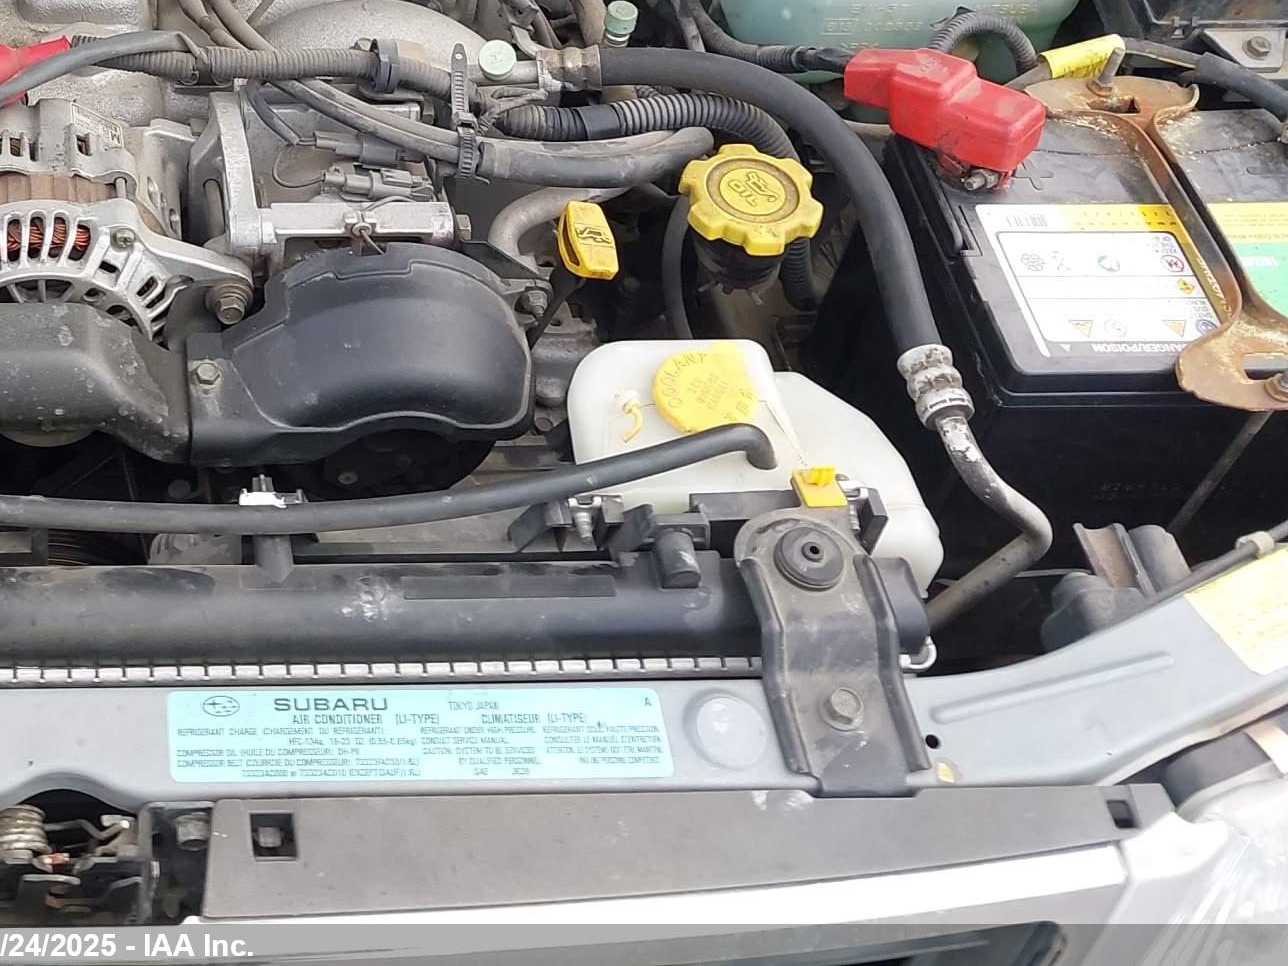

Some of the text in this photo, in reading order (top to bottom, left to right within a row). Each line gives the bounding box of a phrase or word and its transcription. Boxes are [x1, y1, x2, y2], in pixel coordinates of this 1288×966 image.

[727, 178, 758, 207] OIL
[659, 352, 708, 409] COOLANT
[274, 698, 388, 712] SUBARU
[475, 701, 499, 711] JAPAN
[644, 697, 652, 707] A
[292, 714, 311, 724] AIR
[314, 714, 383, 724] CONDITIONER
[481, 713, 541, 724] CLIMATISEUR
